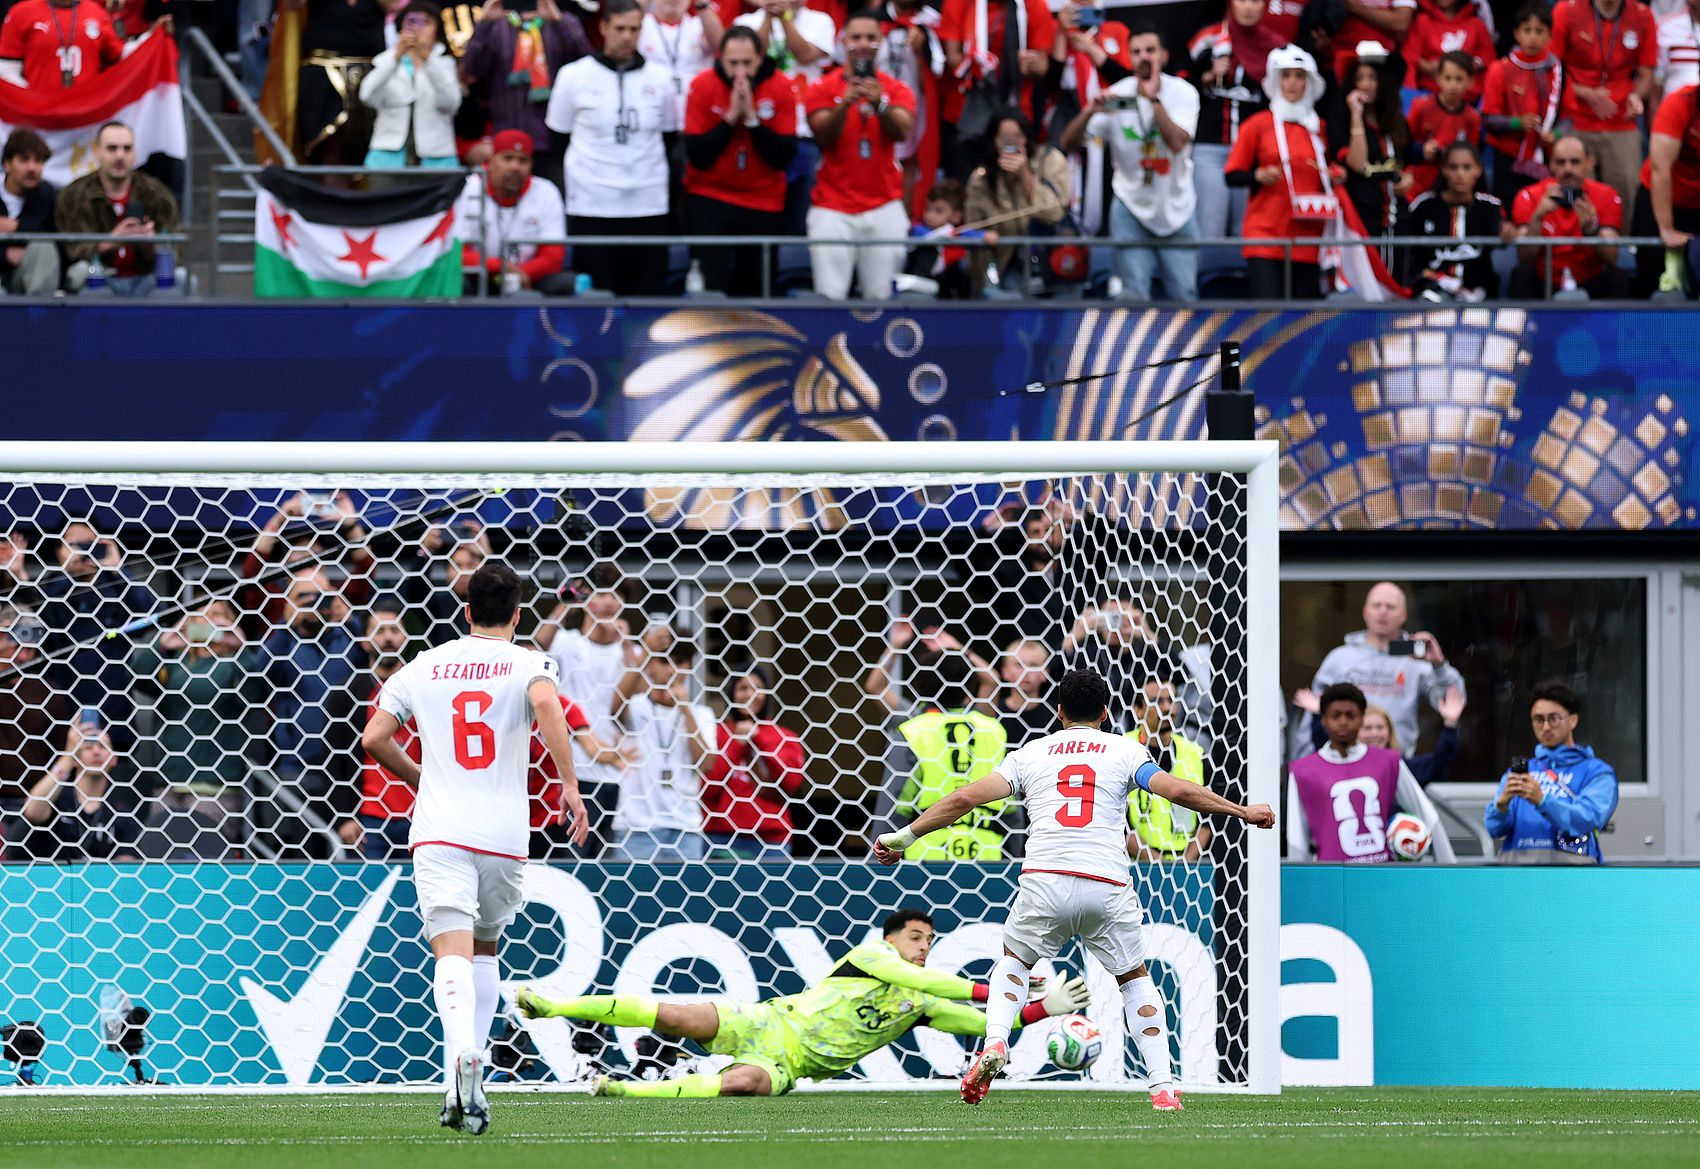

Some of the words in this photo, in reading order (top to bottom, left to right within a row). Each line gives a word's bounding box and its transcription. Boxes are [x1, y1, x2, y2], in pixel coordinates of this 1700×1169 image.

[431, 662, 513, 681] S.EZATOLAHI
[452, 690, 496, 770] 6
[1047, 740, 1107, 755] TAREMI
[1055, 763, 1096, 828] 9
